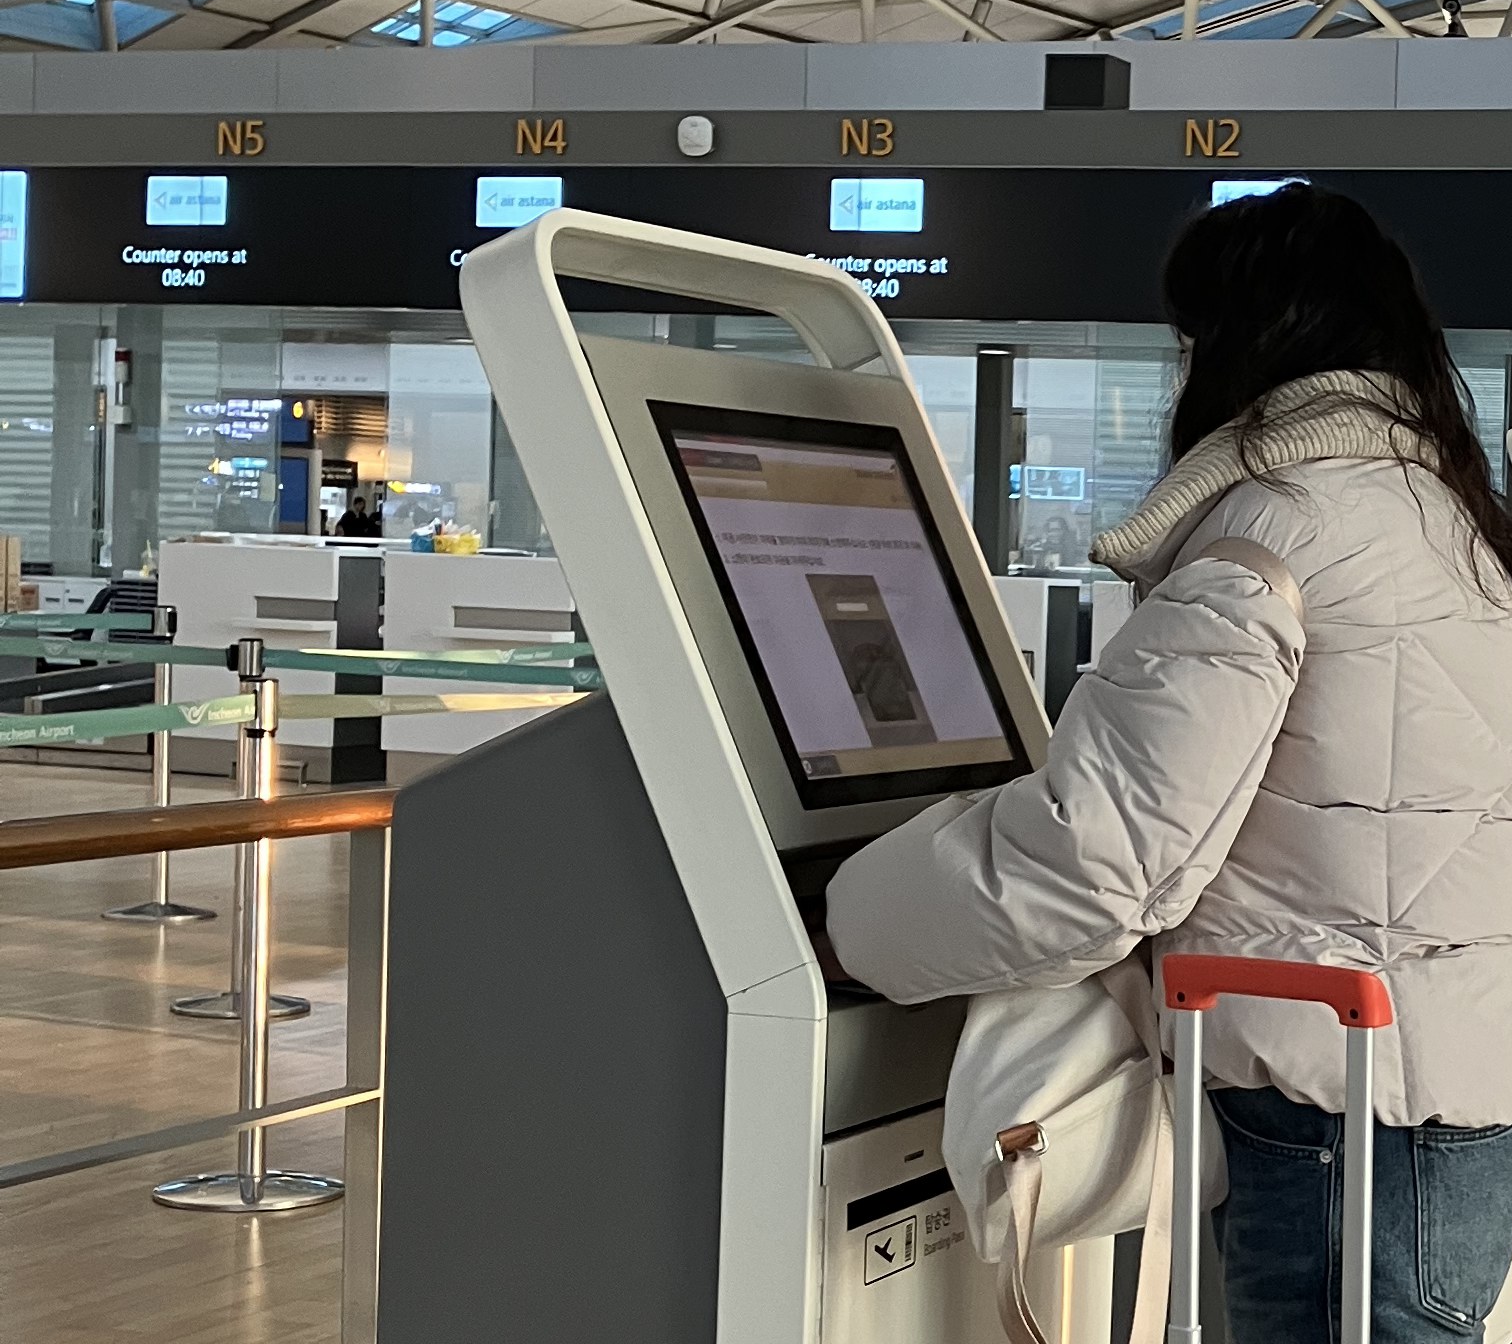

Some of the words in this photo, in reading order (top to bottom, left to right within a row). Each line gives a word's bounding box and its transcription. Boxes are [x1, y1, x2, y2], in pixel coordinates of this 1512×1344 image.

[217, 120, 266, 156] N5
[516, 119, 567, 155] N4
[840, 118, 895, 157] N3
[1184, 118, 1241, 158] N2
[500, 195, 514, 207] air
[518, 196, 556, 208] astana
[857, 198, 872, 211] air
[876, 198, 916, 211] astana
[122, 246, 181, 265] Counter
[183, 249, 228, 267] opens
[231, 248, 247, 264] at
[874, 258, 927, 277] opens
[929, 257, 949, 273] at
[161, 268, 206, 287] 08:40
[857, 278, 900, 299] 8:40
[0, 728, 36, 742] ncheon
[38, 724, 75, 740] Airport
